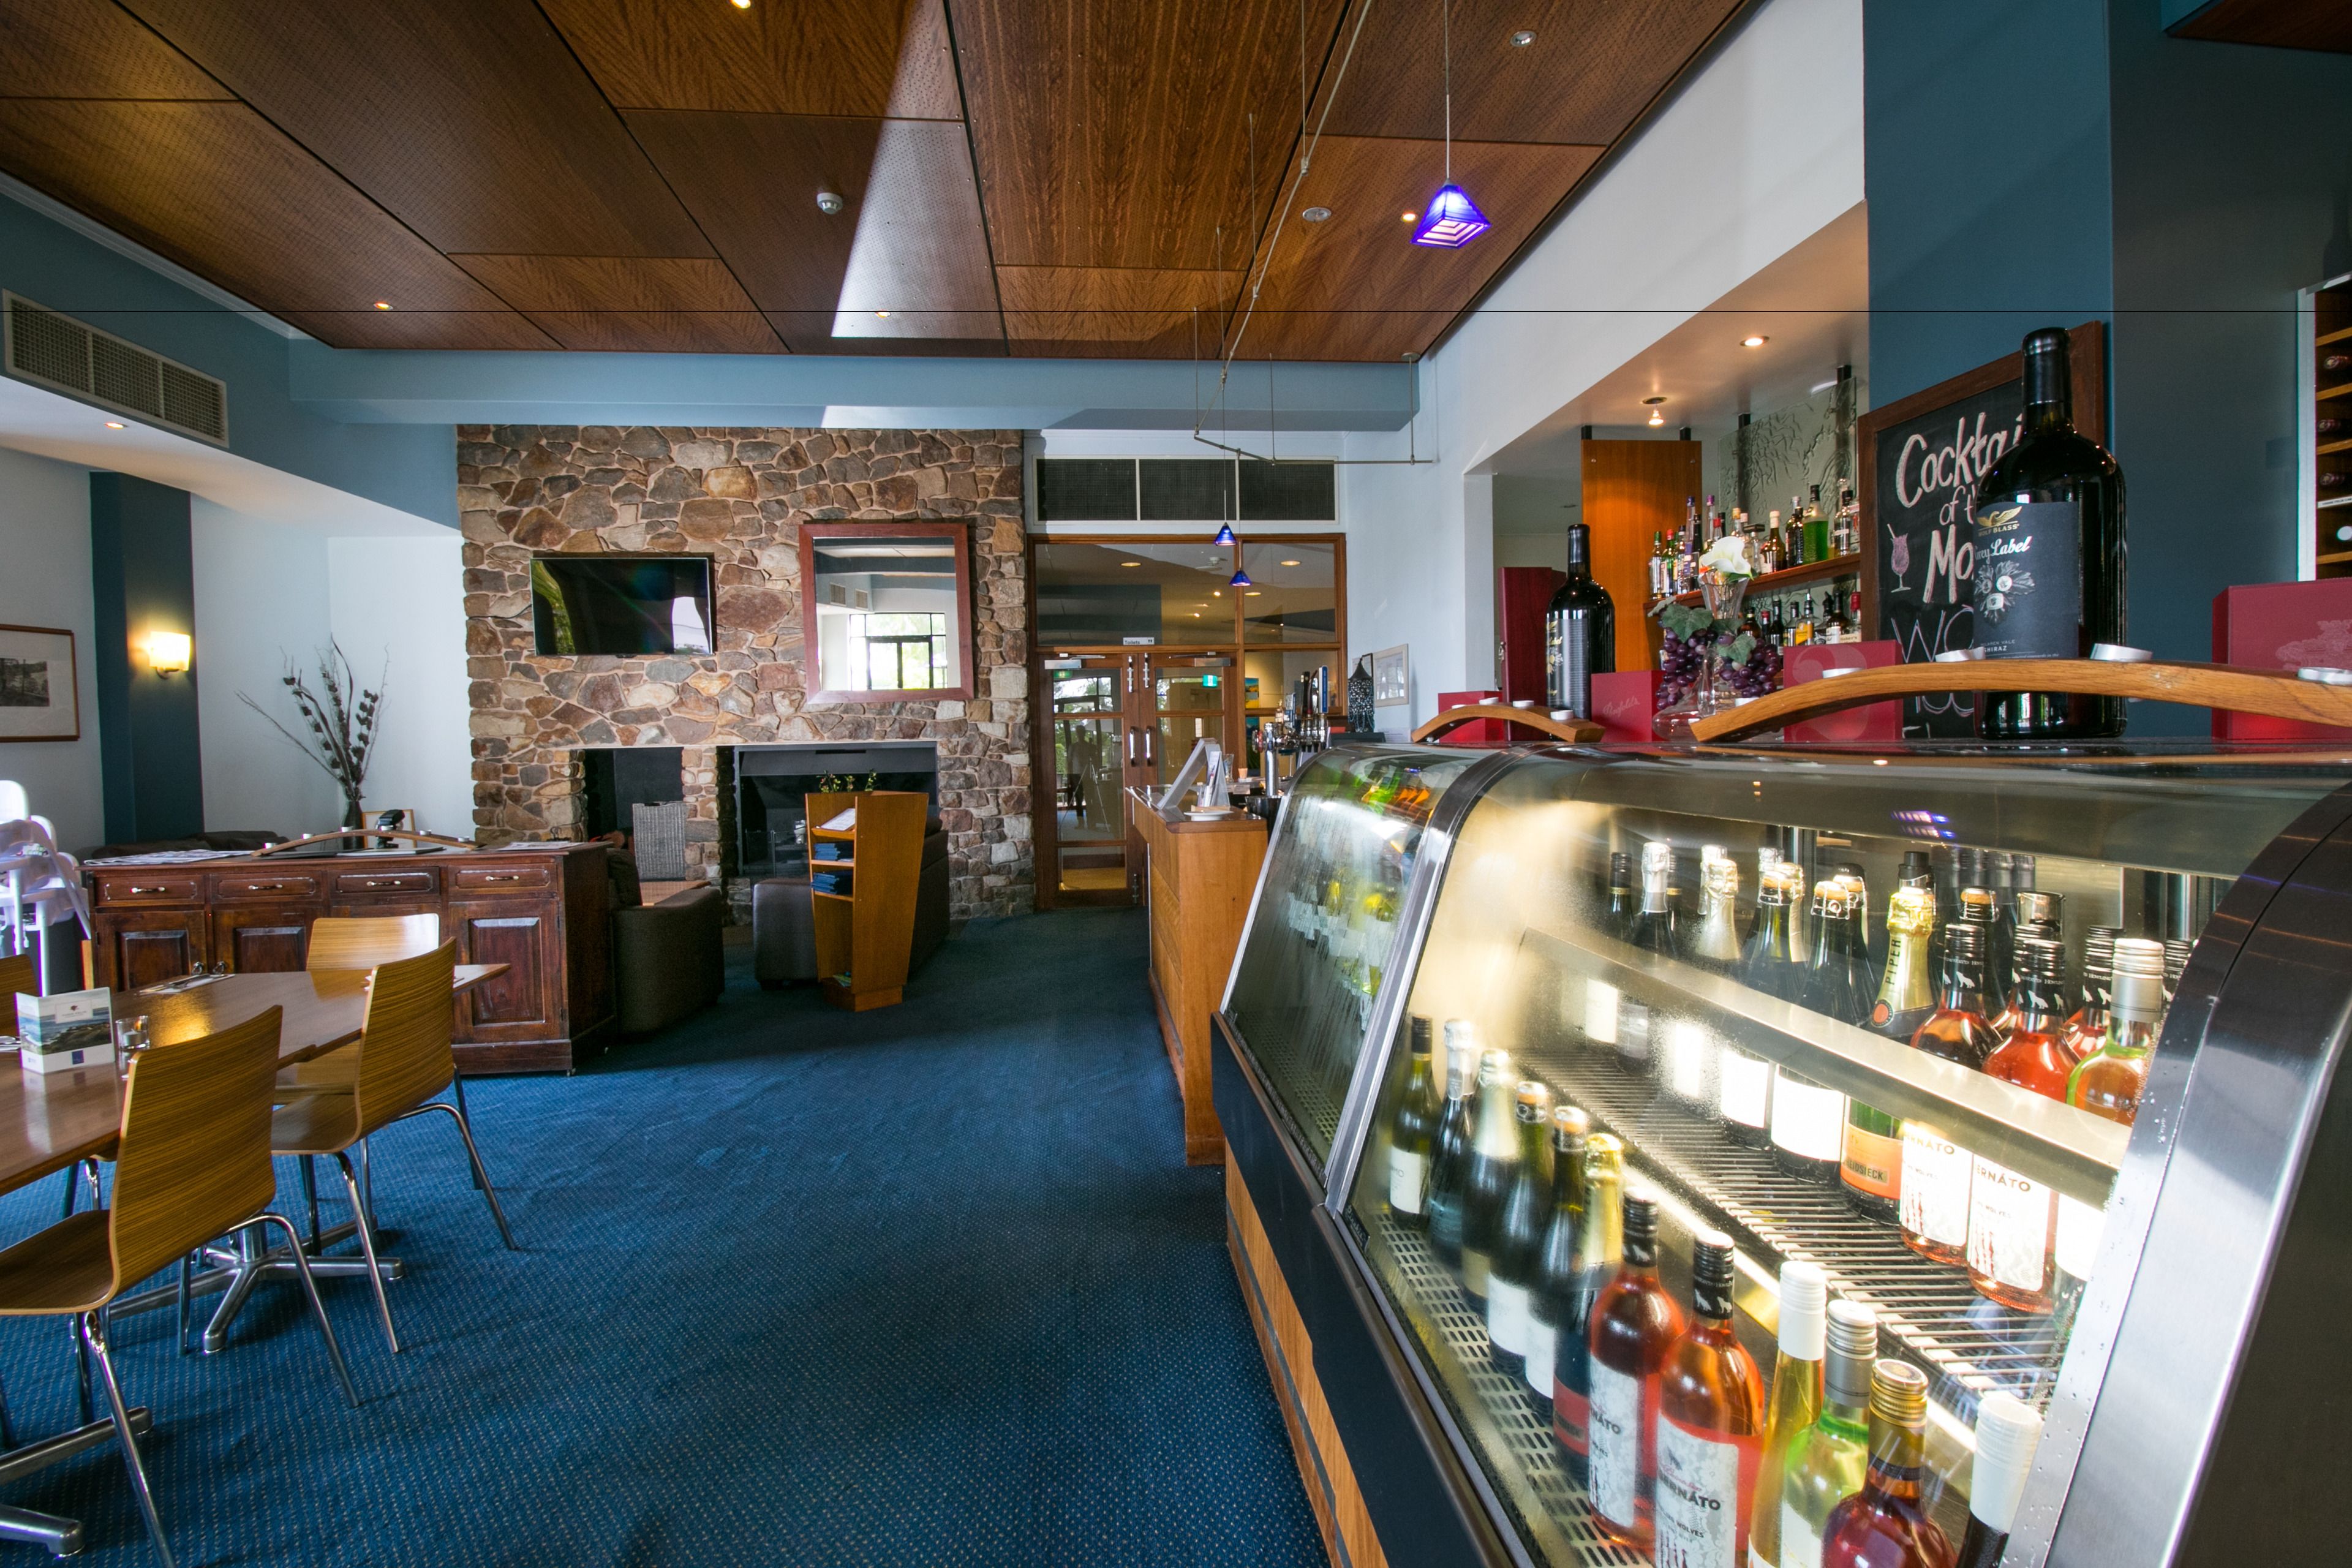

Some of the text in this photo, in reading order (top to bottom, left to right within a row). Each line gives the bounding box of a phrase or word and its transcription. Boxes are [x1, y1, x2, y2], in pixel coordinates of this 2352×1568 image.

[1939, 486, 1966, 520] of
[1993, 524, 2019, 533] BLASS
[1990, 536, 2032, 556] Label
[1922, 524, 1974, 604] Mo
[1676, 1520, 1705, 1539] WOLVES
